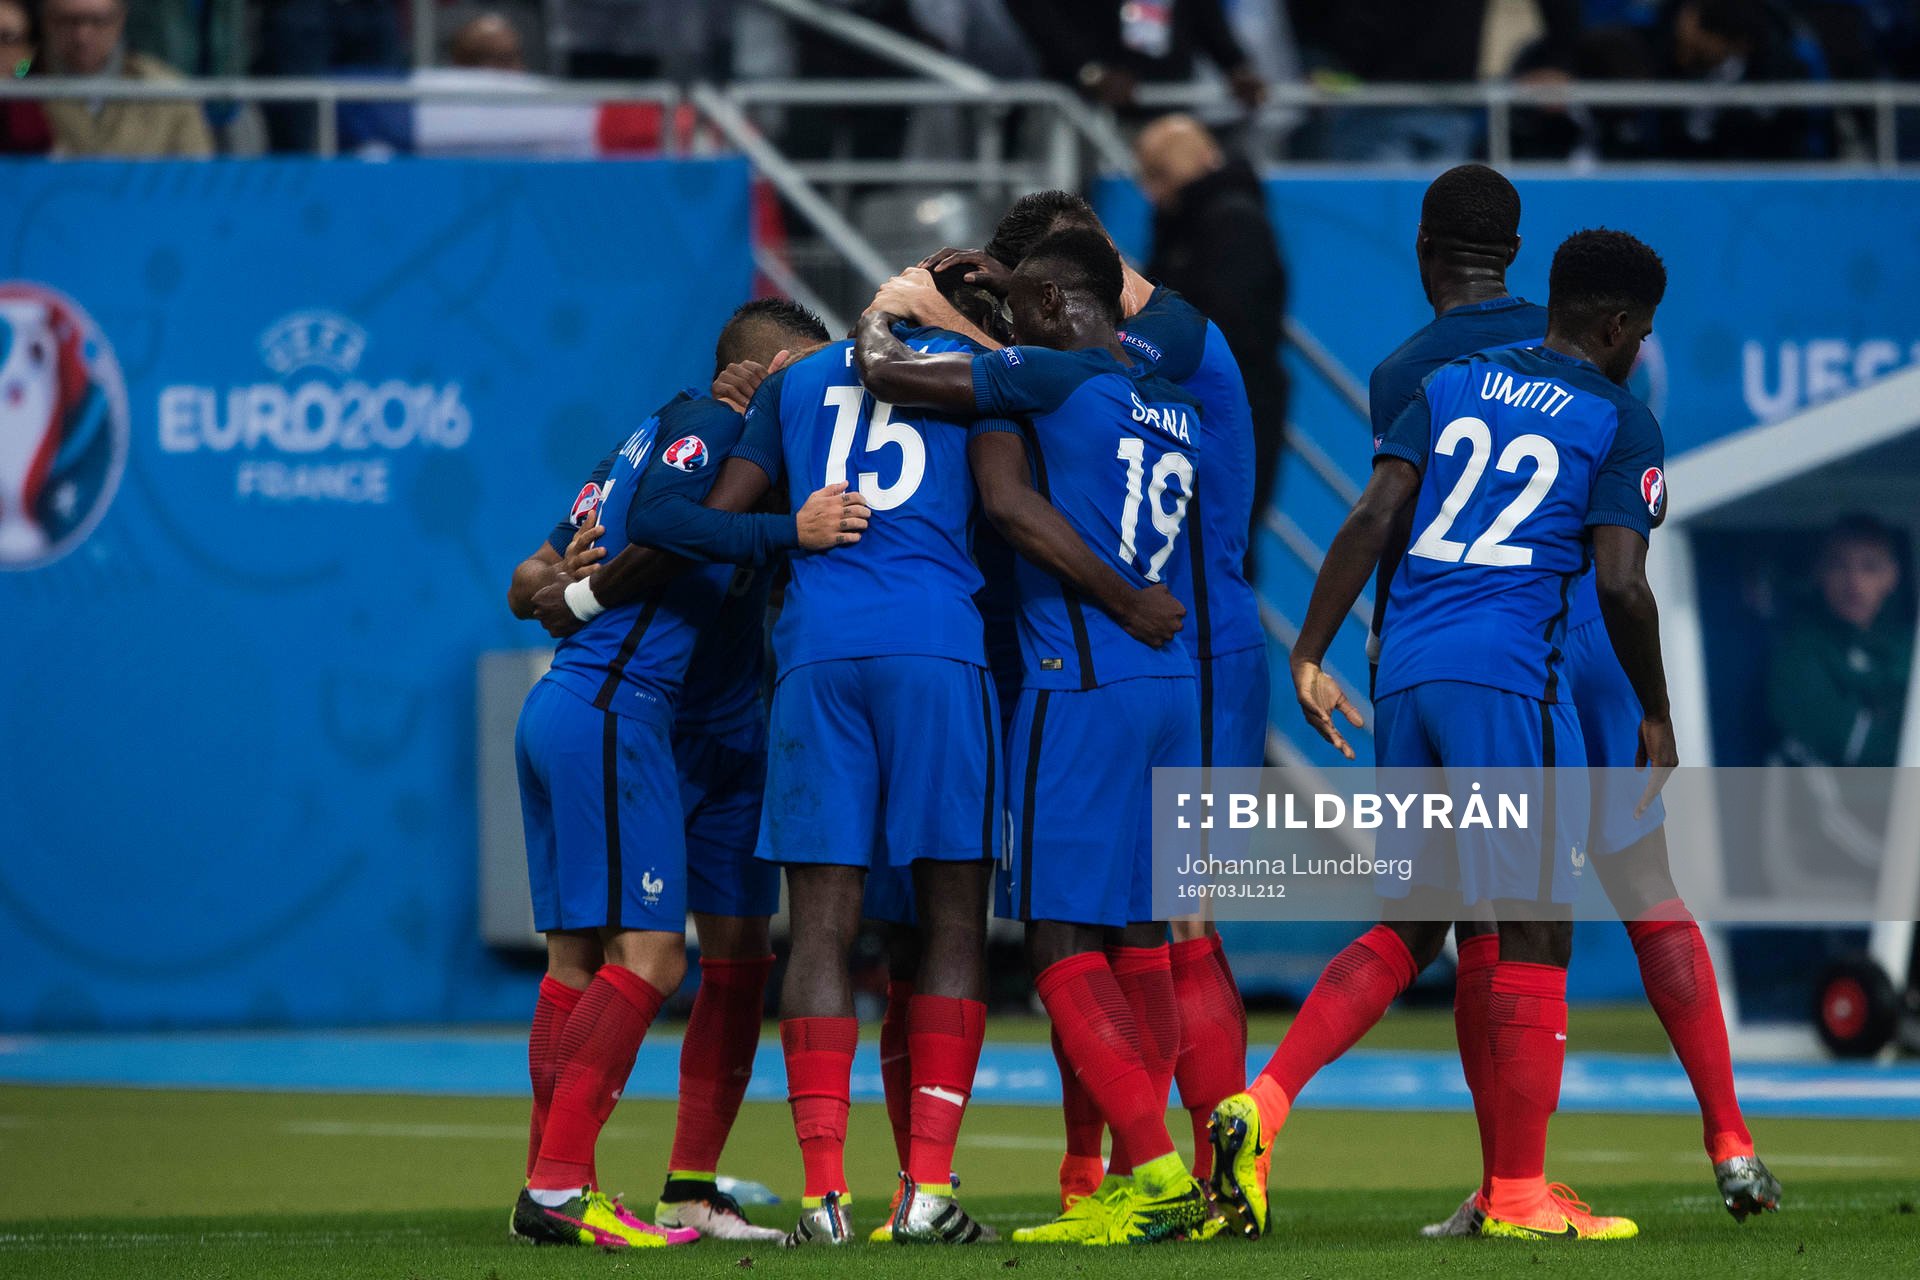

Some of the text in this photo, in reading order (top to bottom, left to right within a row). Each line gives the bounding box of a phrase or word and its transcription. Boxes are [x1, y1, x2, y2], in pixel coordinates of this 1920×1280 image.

[1125, 335, 1162, 361] RESPECT
[1480, 371, 1575, 418] UMTITI
[236, 460, 391, 503] FRANCE
[823, 385, 927, 512] 15
[1408, 416, 1560, 567] 22
[1116, 436, 1194, 583] 19
